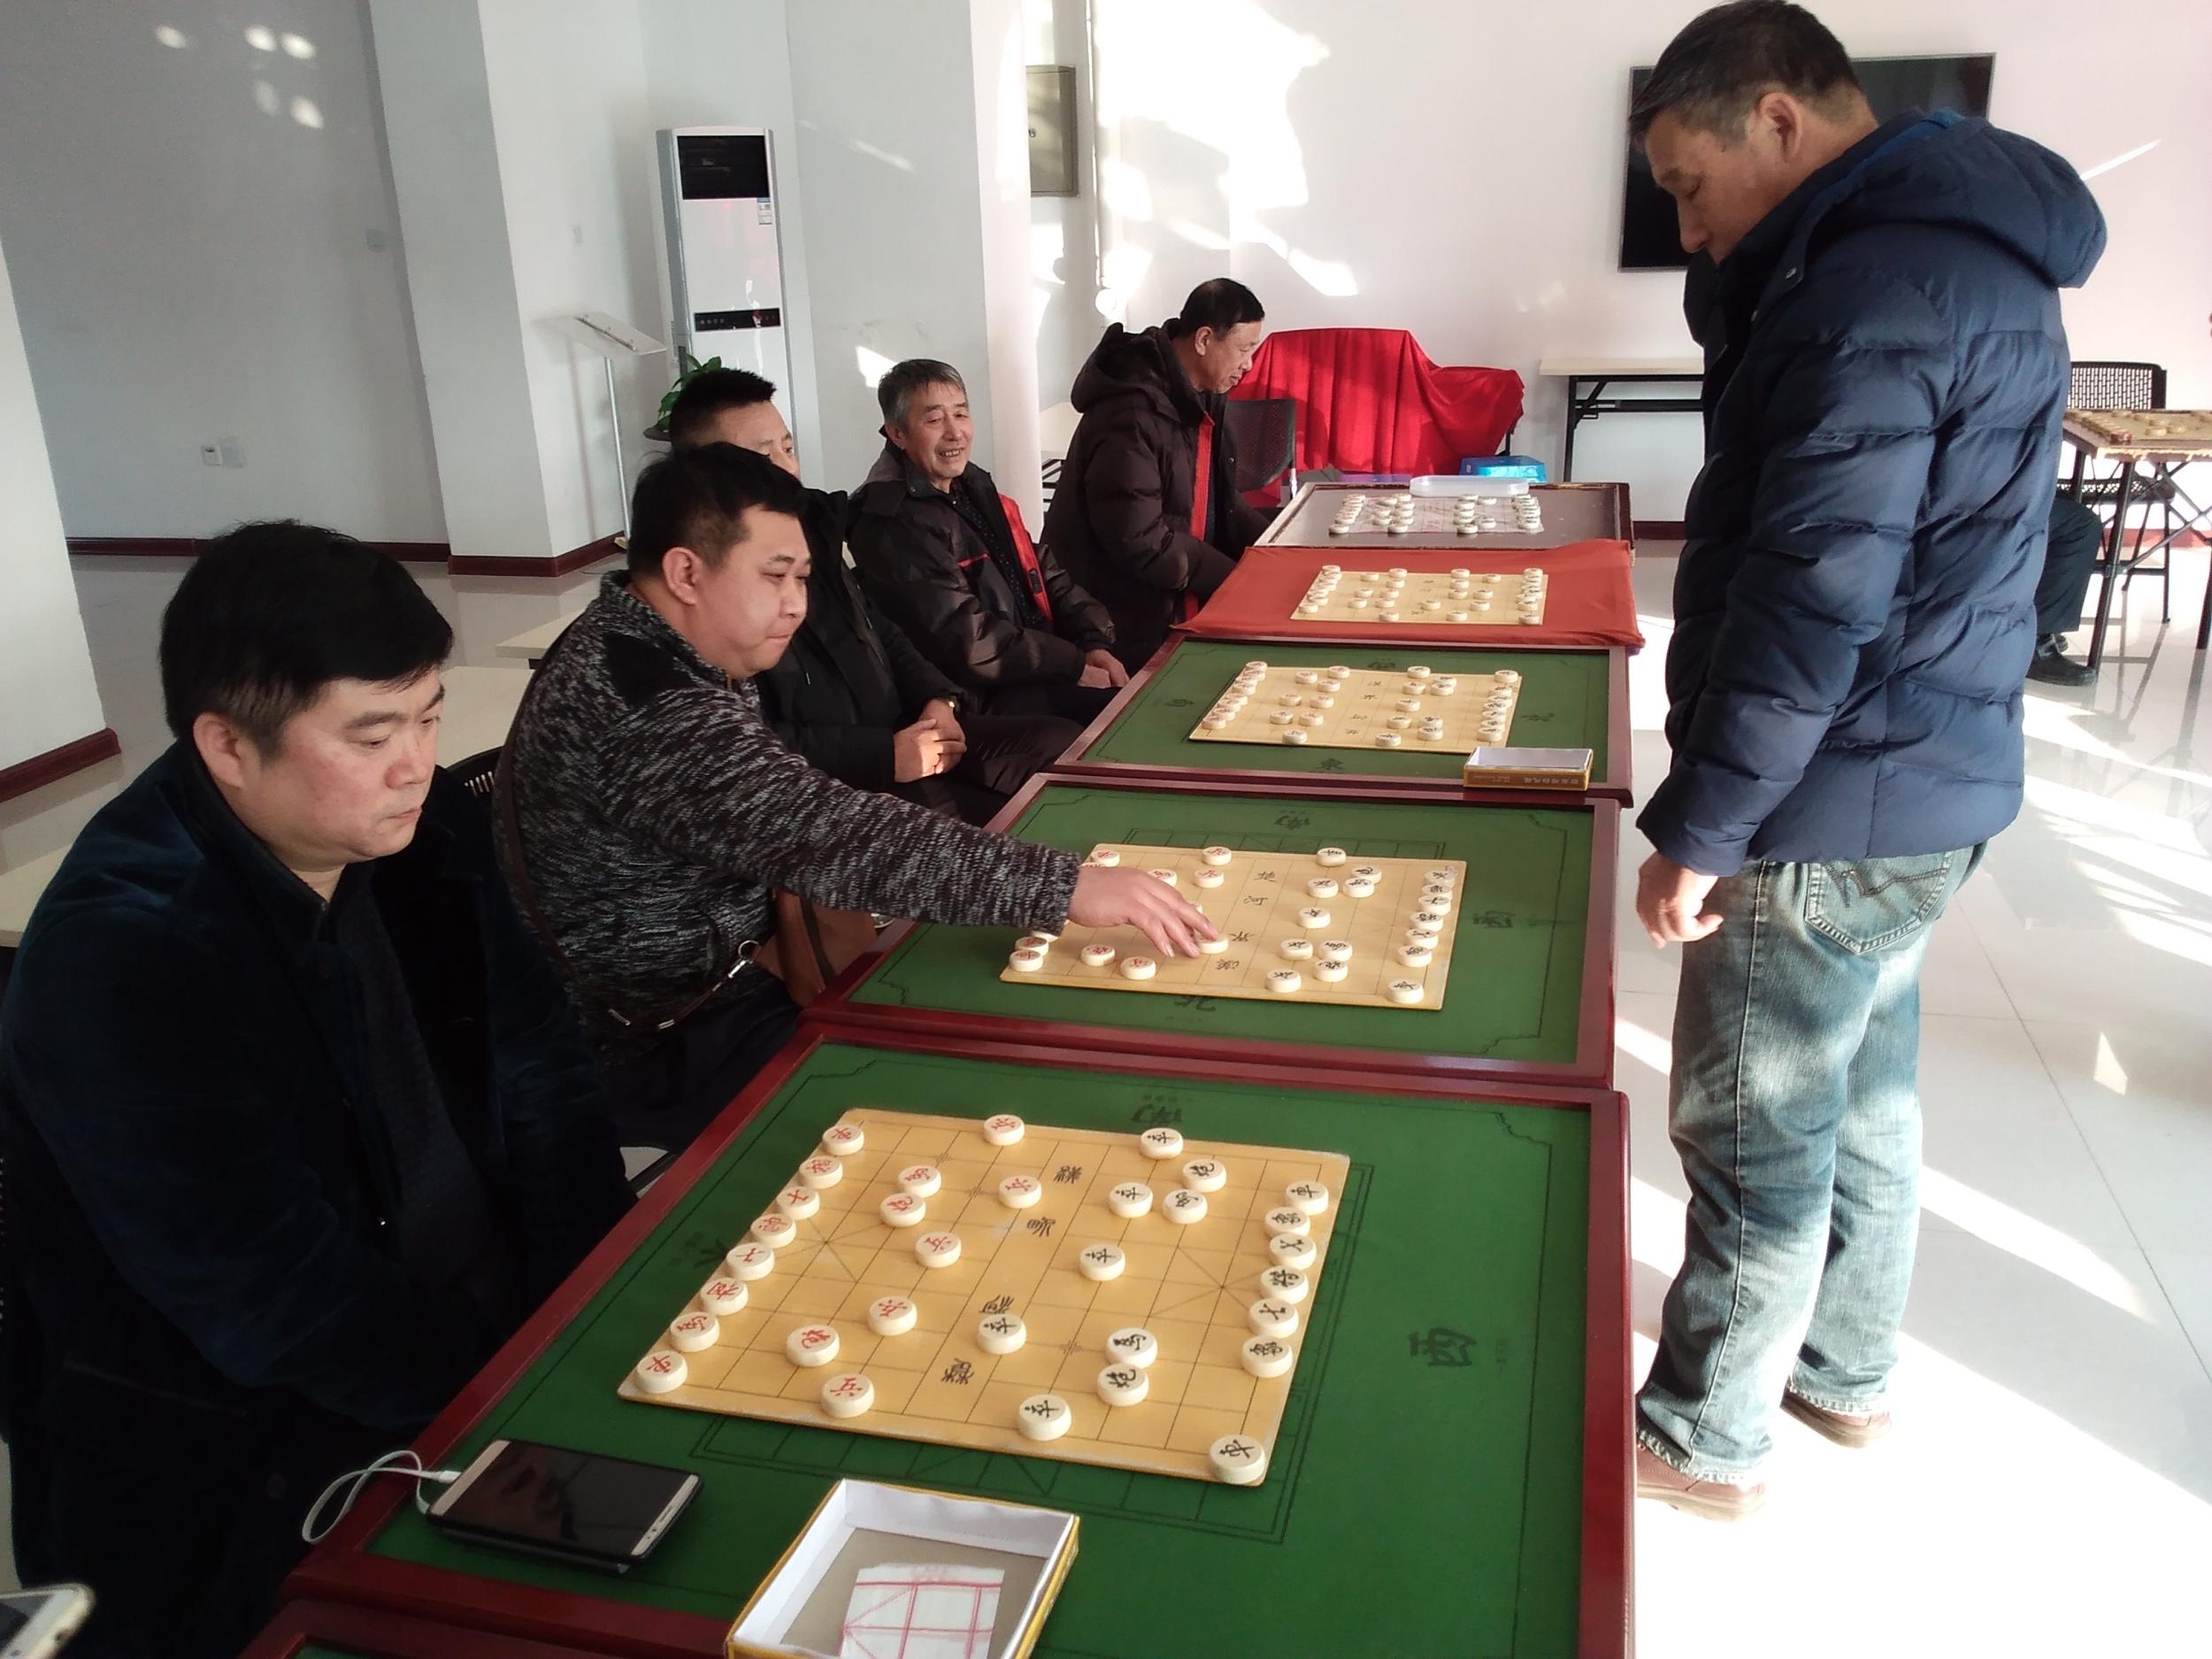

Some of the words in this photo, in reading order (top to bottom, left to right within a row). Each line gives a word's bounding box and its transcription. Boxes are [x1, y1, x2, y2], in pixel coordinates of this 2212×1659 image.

[990, 1117, 1018, 1130] 兵
[1146, 1131, 1176, 1145] 卒
[903, 1167, 931, 1182] 馬
[1005, 1178, 1032, 1192] 兵
[1291, 1185, 1318, 1198] 車
[1115, 1187, 1143, 1200] 卒
[1271, 1213, 1301, 1224] 象
[925, 1237, 951, 1251] 兵
[1280, 1240, 1304, 1252] 士
[1086, 1249, 1115, 1263] 卒
[1270, 1269, 1299, 1287] 將
[879, 1301, 908, 1317] 兵
[1259, 1303, 1286, 1320] 士
[677, 1316, 707, 1332] 馬
[984, 1318, 1017, 1333] 卒
[1113, 1334, 1146, 1350] 馬
[1249, 1341, 1283, 1356] 象
[830, 1378, 862, 1396] 兵
[1025, 1400, 1058, 1418] 卒
[1219, 1440, 1254, 1458] 車
